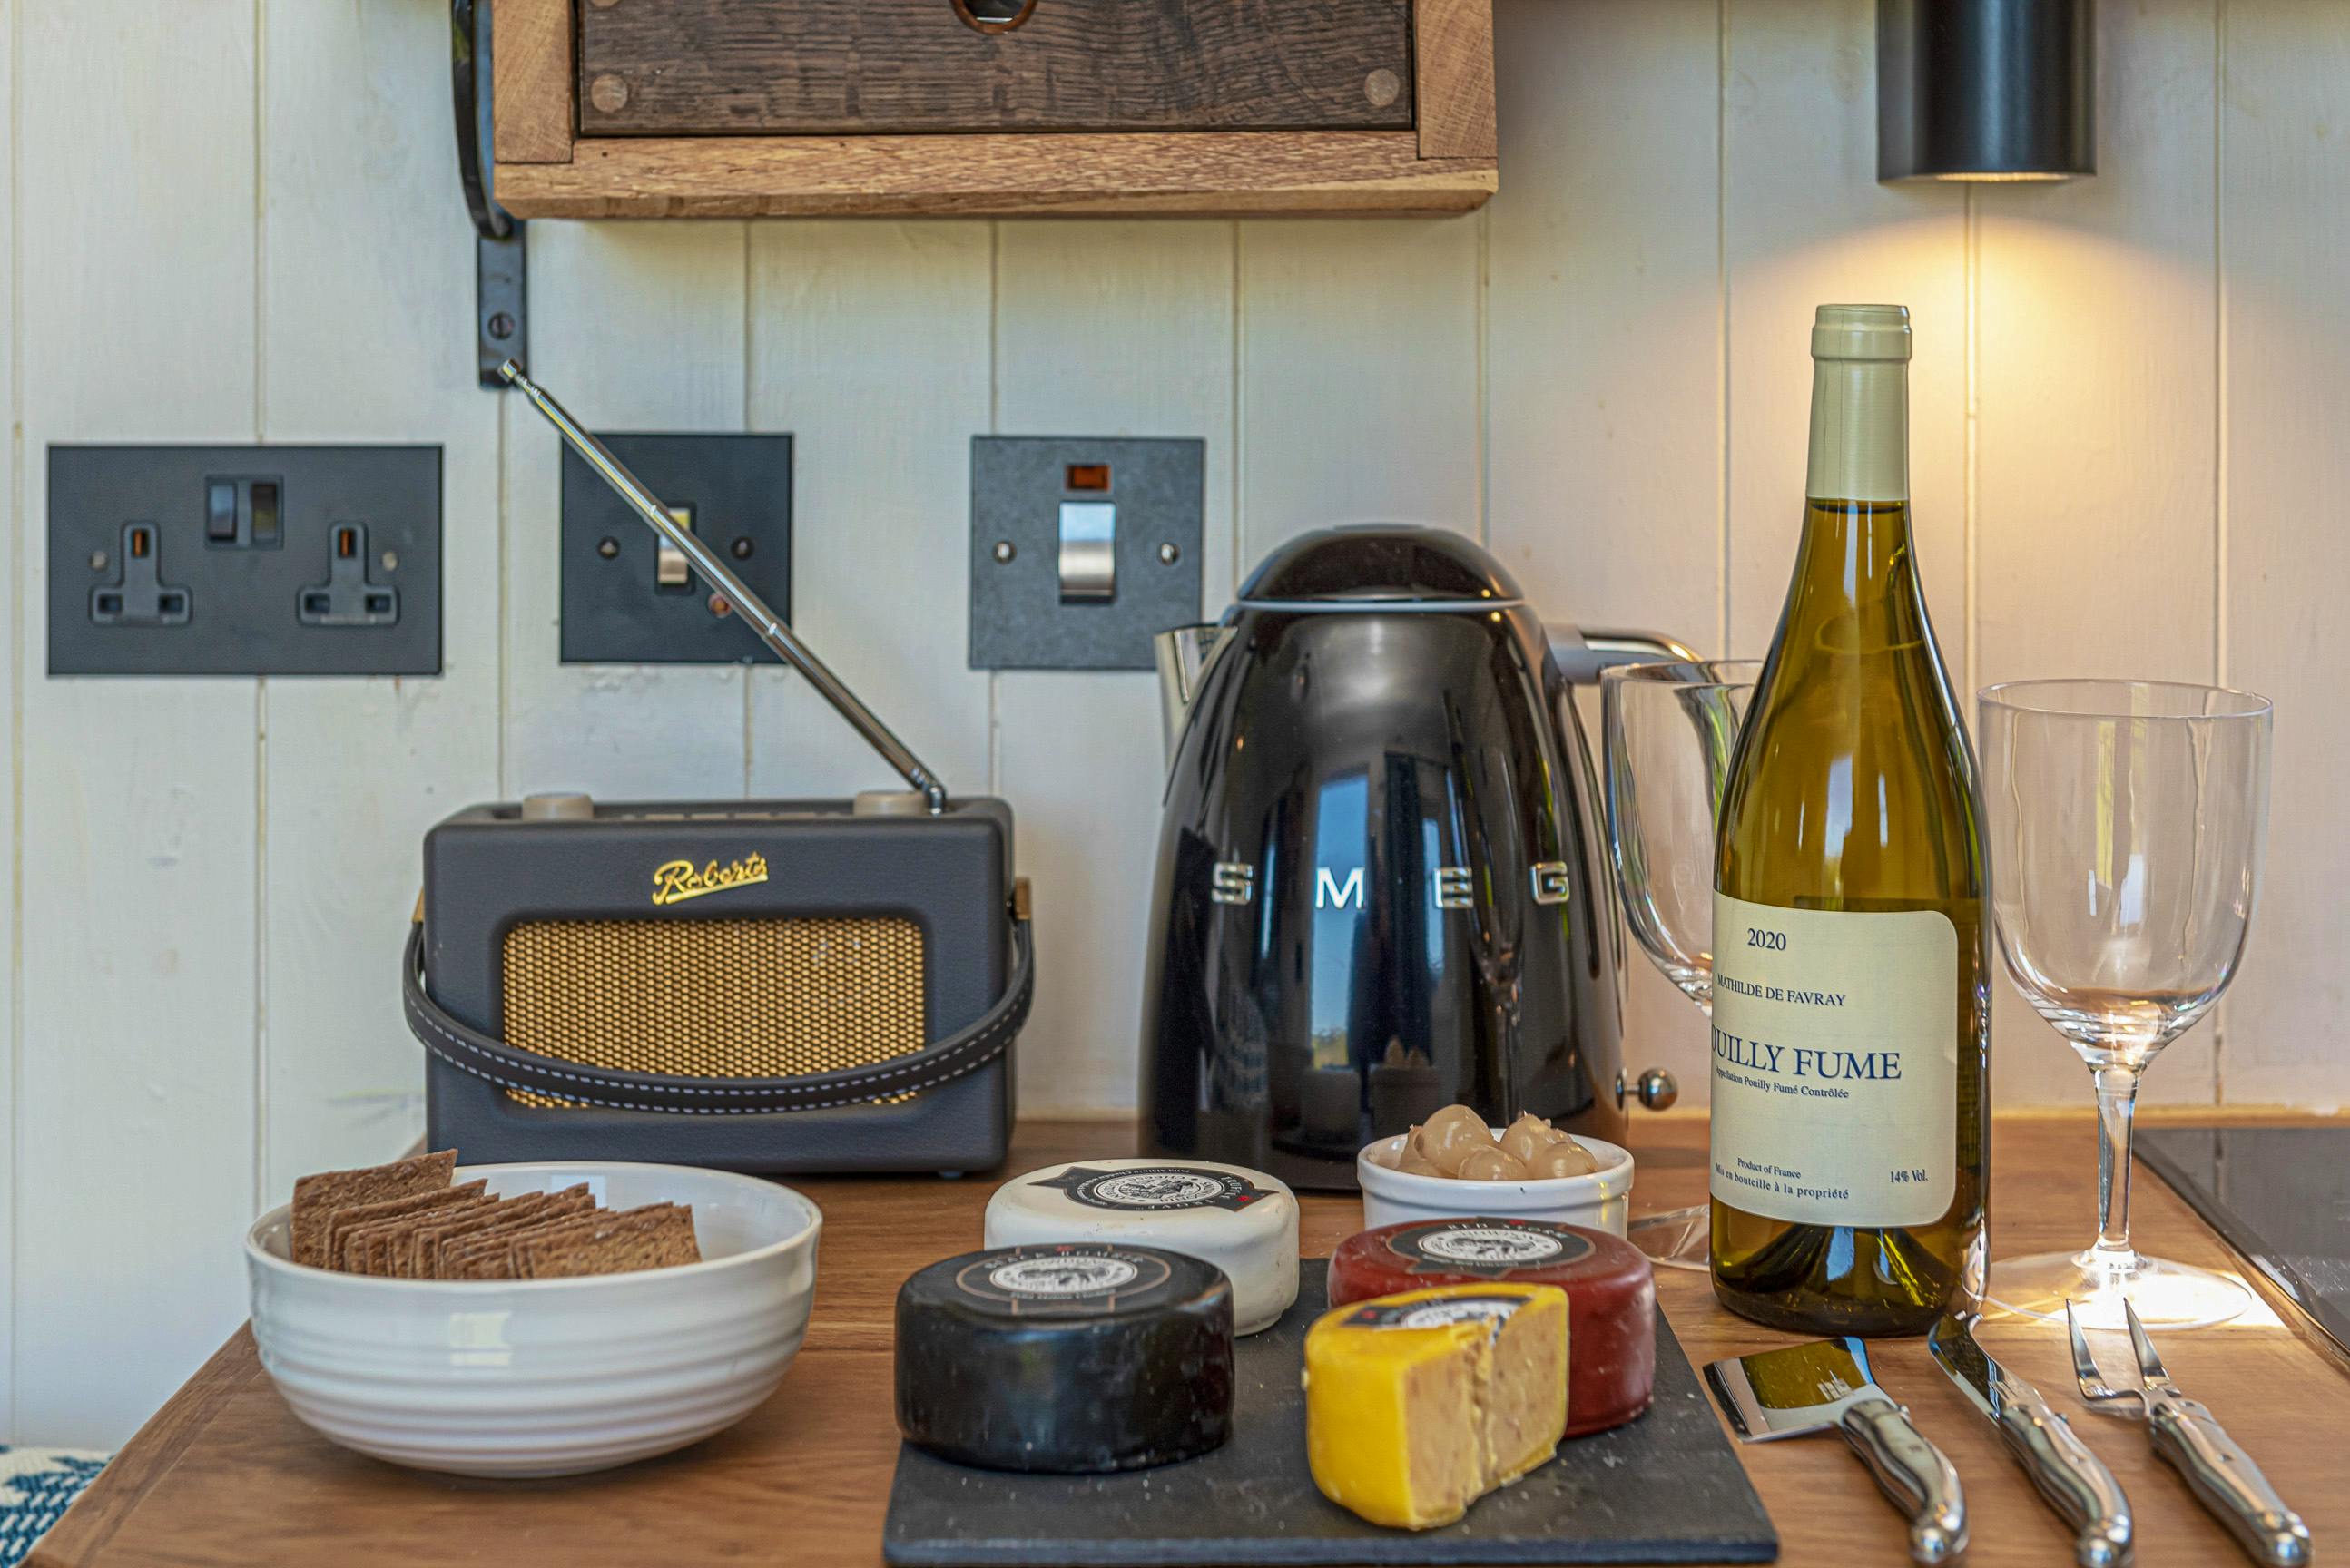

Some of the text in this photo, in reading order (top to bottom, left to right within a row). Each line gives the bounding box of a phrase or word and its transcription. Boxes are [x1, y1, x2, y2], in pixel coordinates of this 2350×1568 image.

[652, 851, 769, 906] Roberts
[1211, 861, 1569, 908] SMEG
[1747, 927, 1786, 951] 2020
[1717, 973, 1846, 1006] MATHILDE DE FAVRAY
[1711, 1024, 1902, 1080] OUILLY FUME
[1745, 1076, 1771, 1093] Pouilly
[1774, 1082, 1798, 1094] Fumé
[1801, 1085, 1849, 1099] Contrôlée
[1737, 1158, 1802, 1180] Product of France
[1891, 1169, 1928, 1183] 14% Vol.
[1726, 1170, 1733, 1179] en
[1735, 1172, 1771, 1191] bouteille
[1775, 1181, 1780, 1192] à
[1784, 1182, 1793, 1194] la
[1797, 1187, 1849, 1200] propriété
